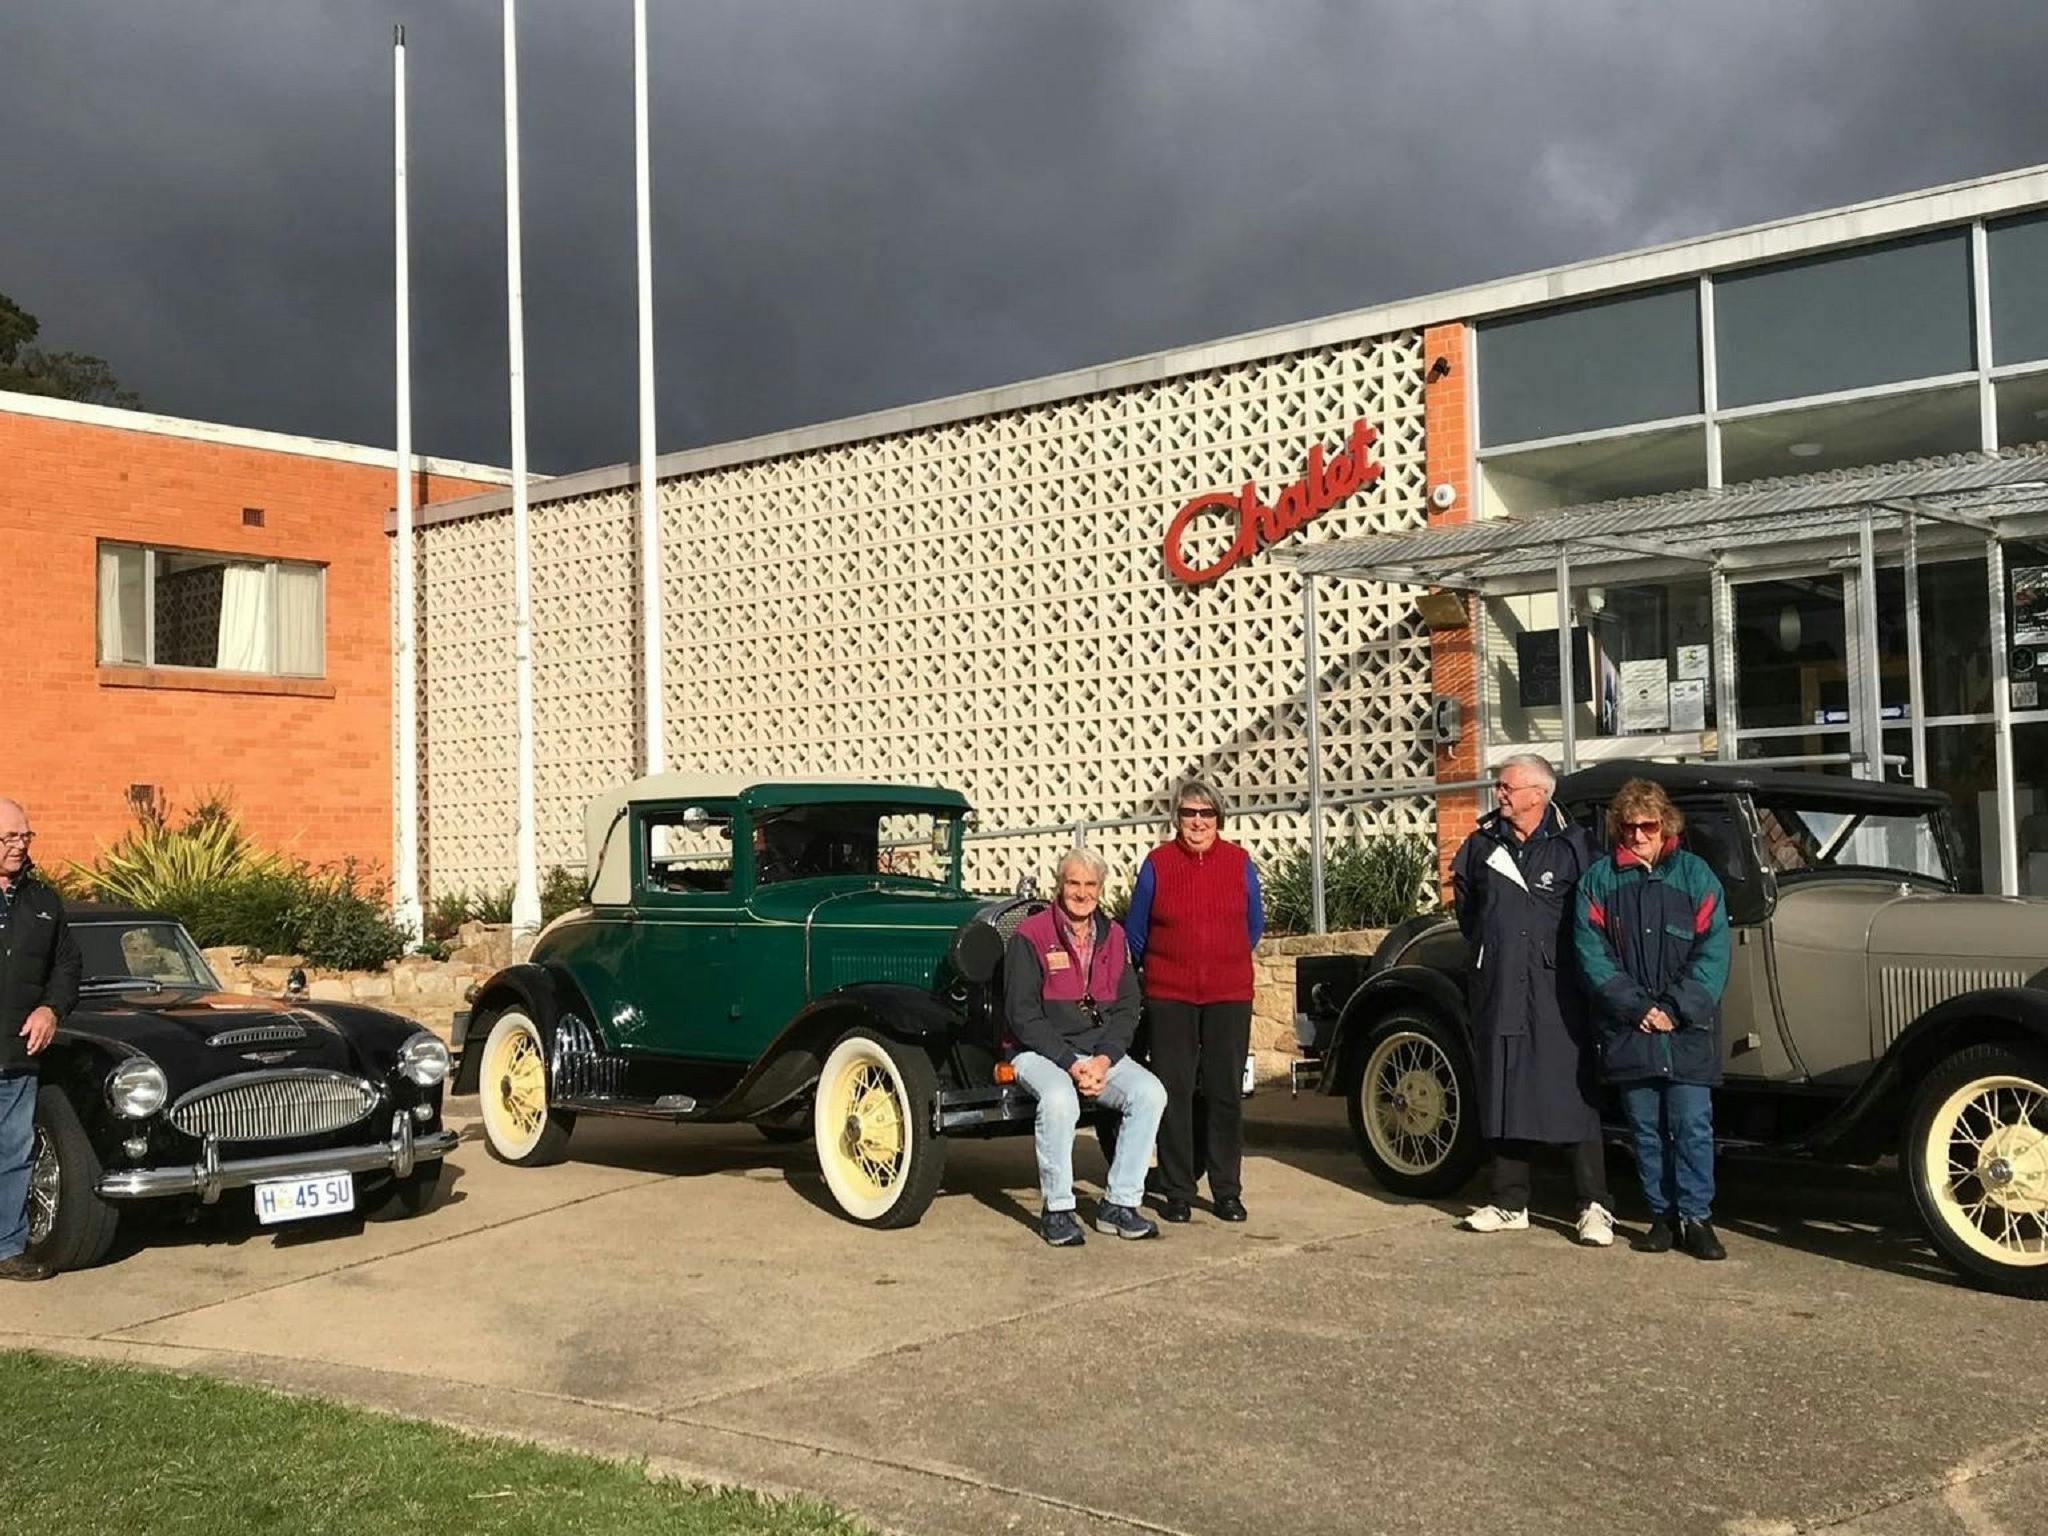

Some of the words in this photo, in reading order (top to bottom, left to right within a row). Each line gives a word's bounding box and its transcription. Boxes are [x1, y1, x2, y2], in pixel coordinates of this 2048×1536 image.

[1163, 416, 1383, 584] Chalet
[261, 1189, 276, 1214] H
[295, 1184, 320, 1209] 45
[325, 1179, 350, 1205] SU
